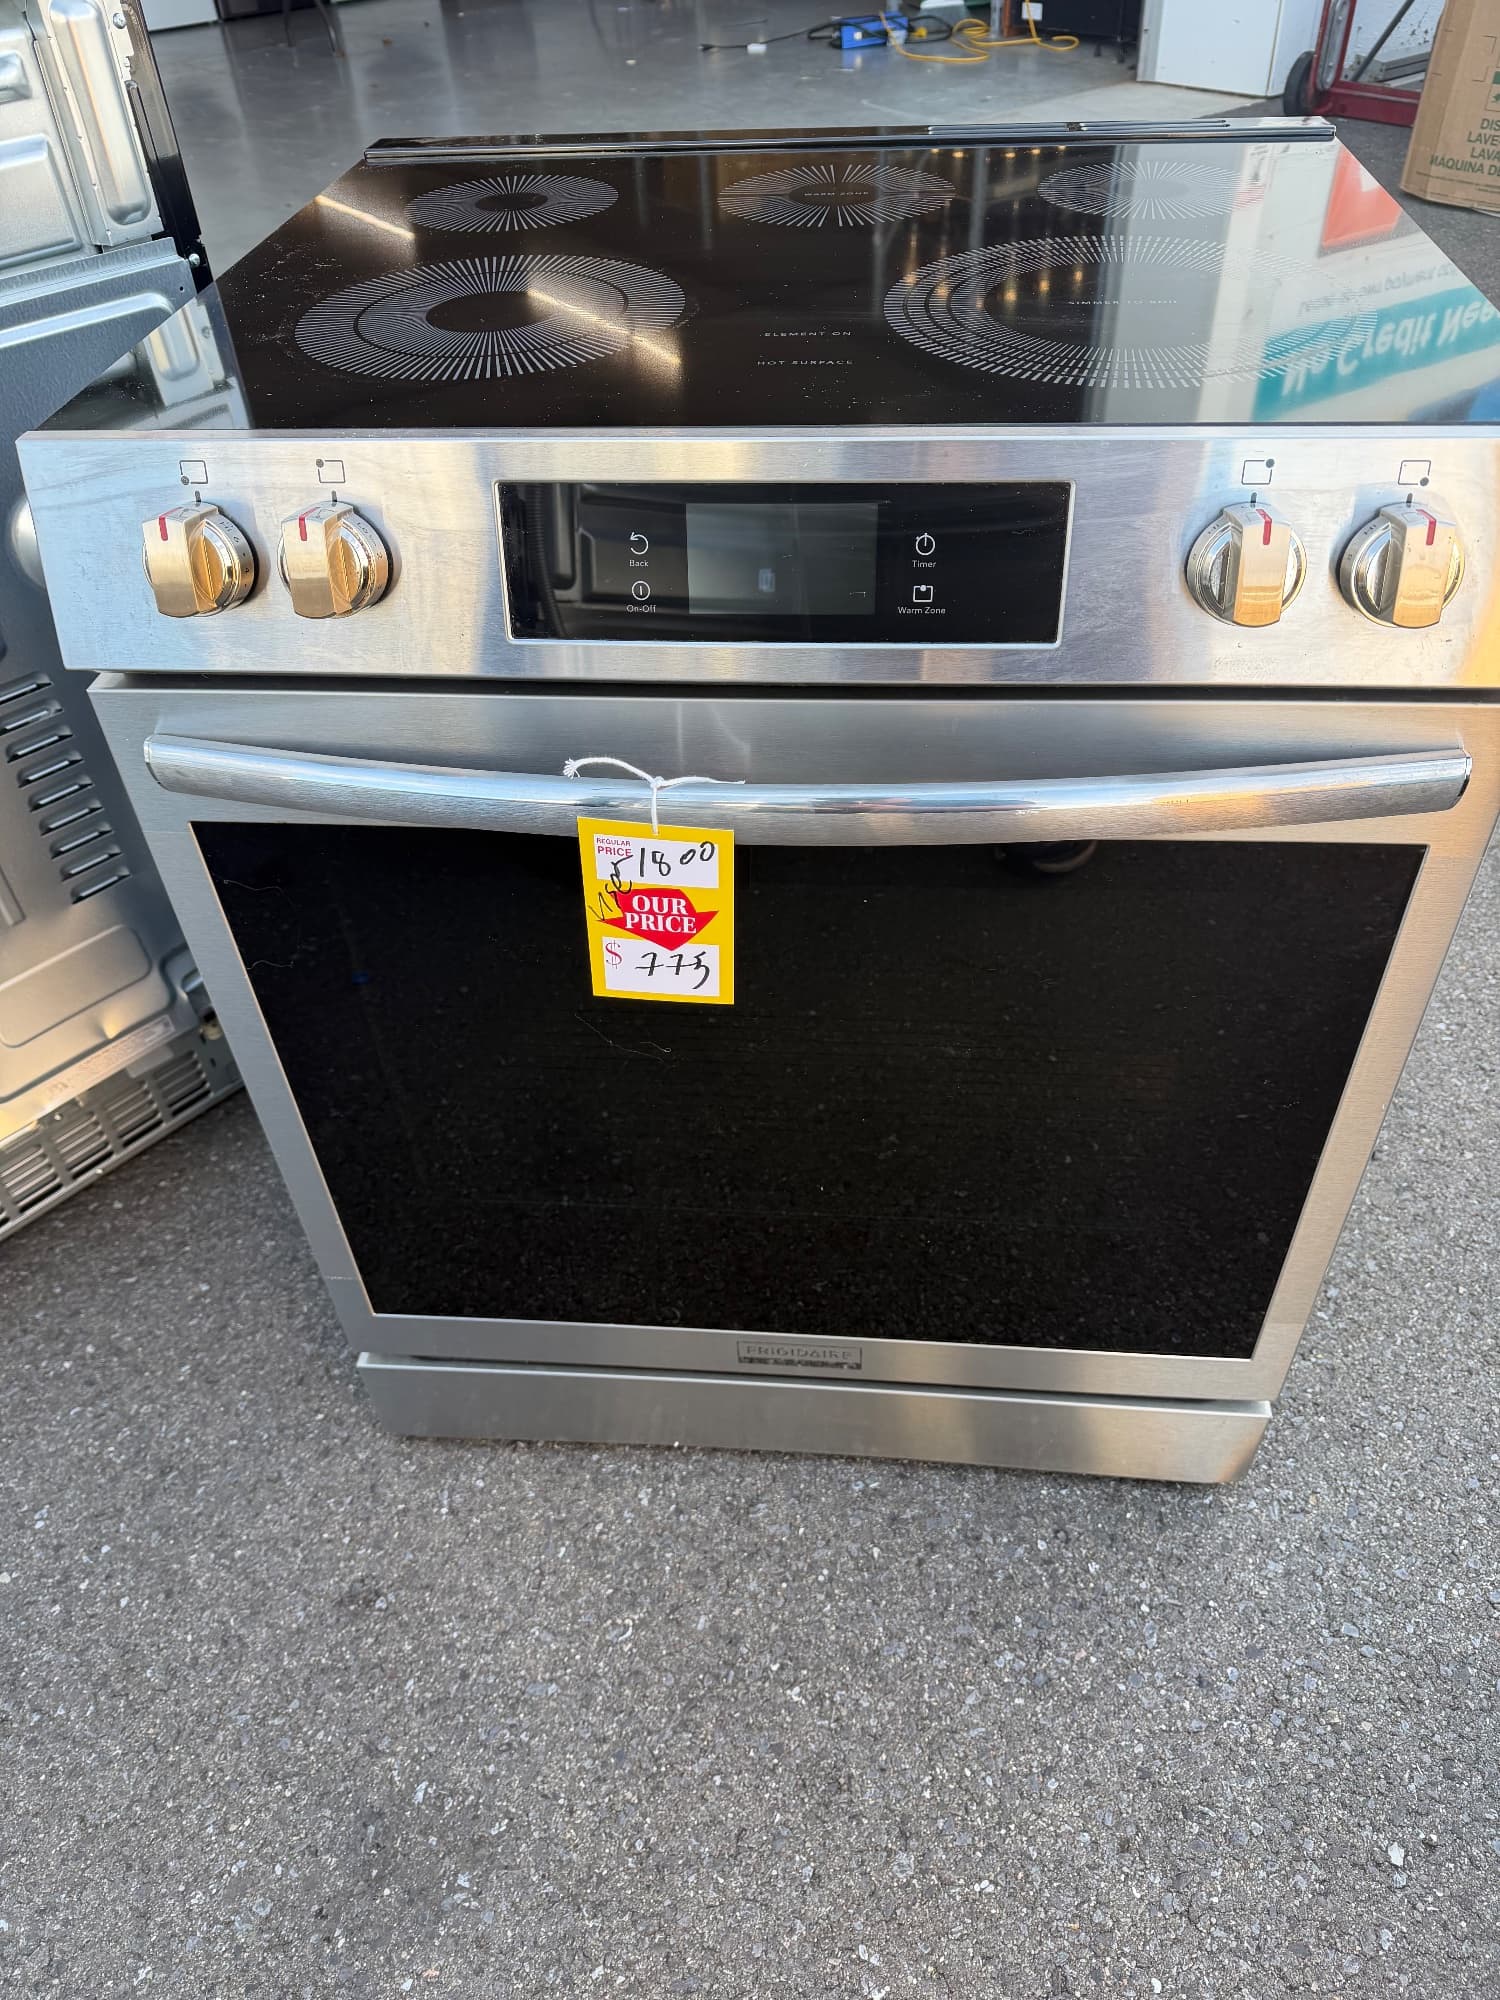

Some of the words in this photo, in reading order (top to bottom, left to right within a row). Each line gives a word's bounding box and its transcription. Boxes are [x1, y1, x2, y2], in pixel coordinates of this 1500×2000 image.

[629, 559, 649, 567] Back
[912, 559, 937, 568] Timer
[626, 604, 657, 613] On-Off
[897, 606, 923, 614] Warm
[924, 606, 946, 614] Zone
[596, 837, 631, 847] REGULAR
[597, 845, 632, 857] PRICE
[632, 895, 688, 915] OUR
[625, 912, 697, 934] PRICE
[635, 951, 710, 990] 775
[745, 1344, 853, 1360] FRIGIDAIRE
